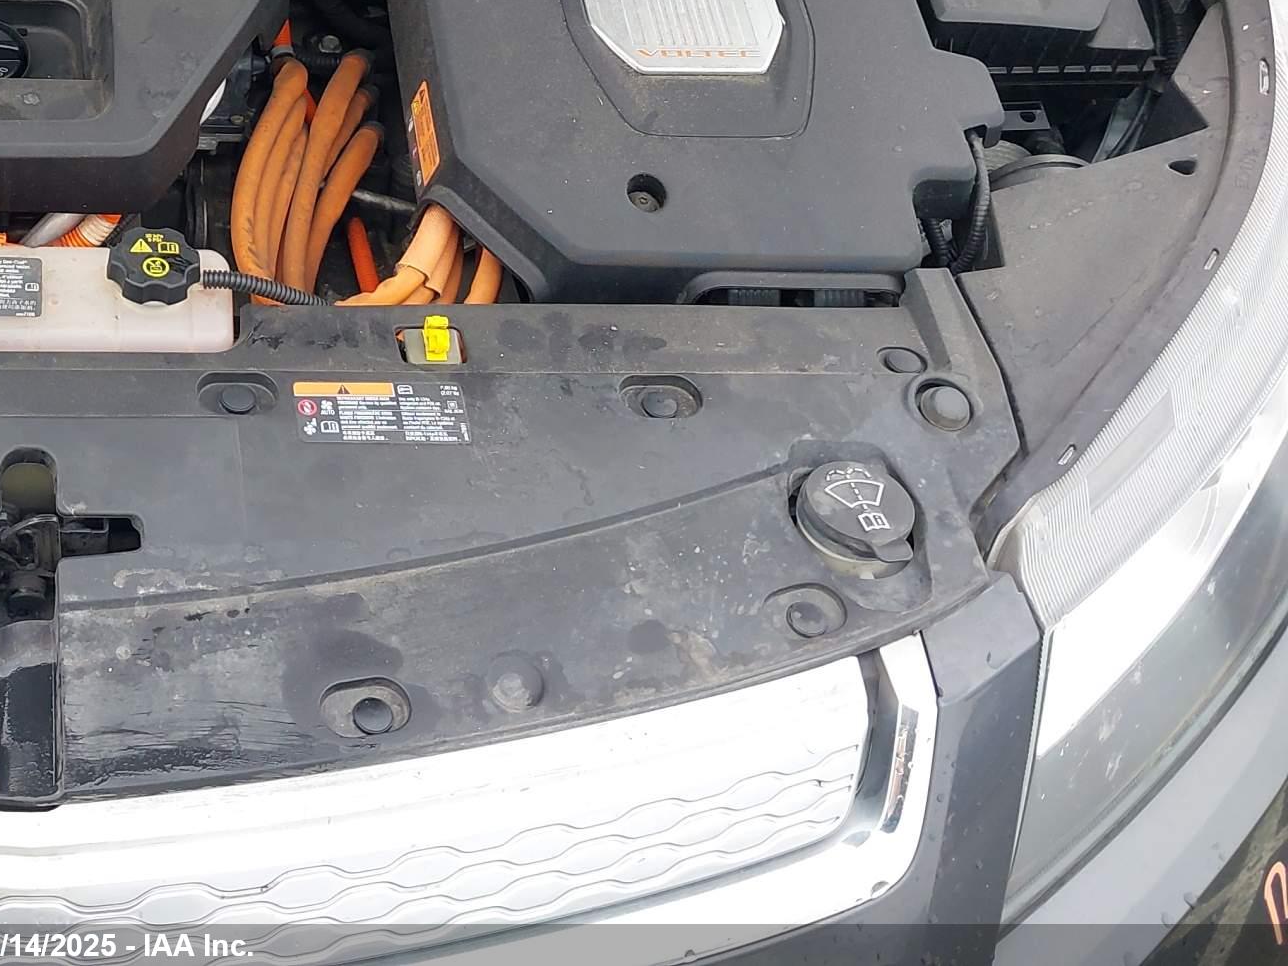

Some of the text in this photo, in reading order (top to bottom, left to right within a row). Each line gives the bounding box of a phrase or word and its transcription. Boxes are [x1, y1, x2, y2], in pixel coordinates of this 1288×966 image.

[637, 48, 760, 58] VOLTEC
[370, 606, 397, 614] DOT 3
